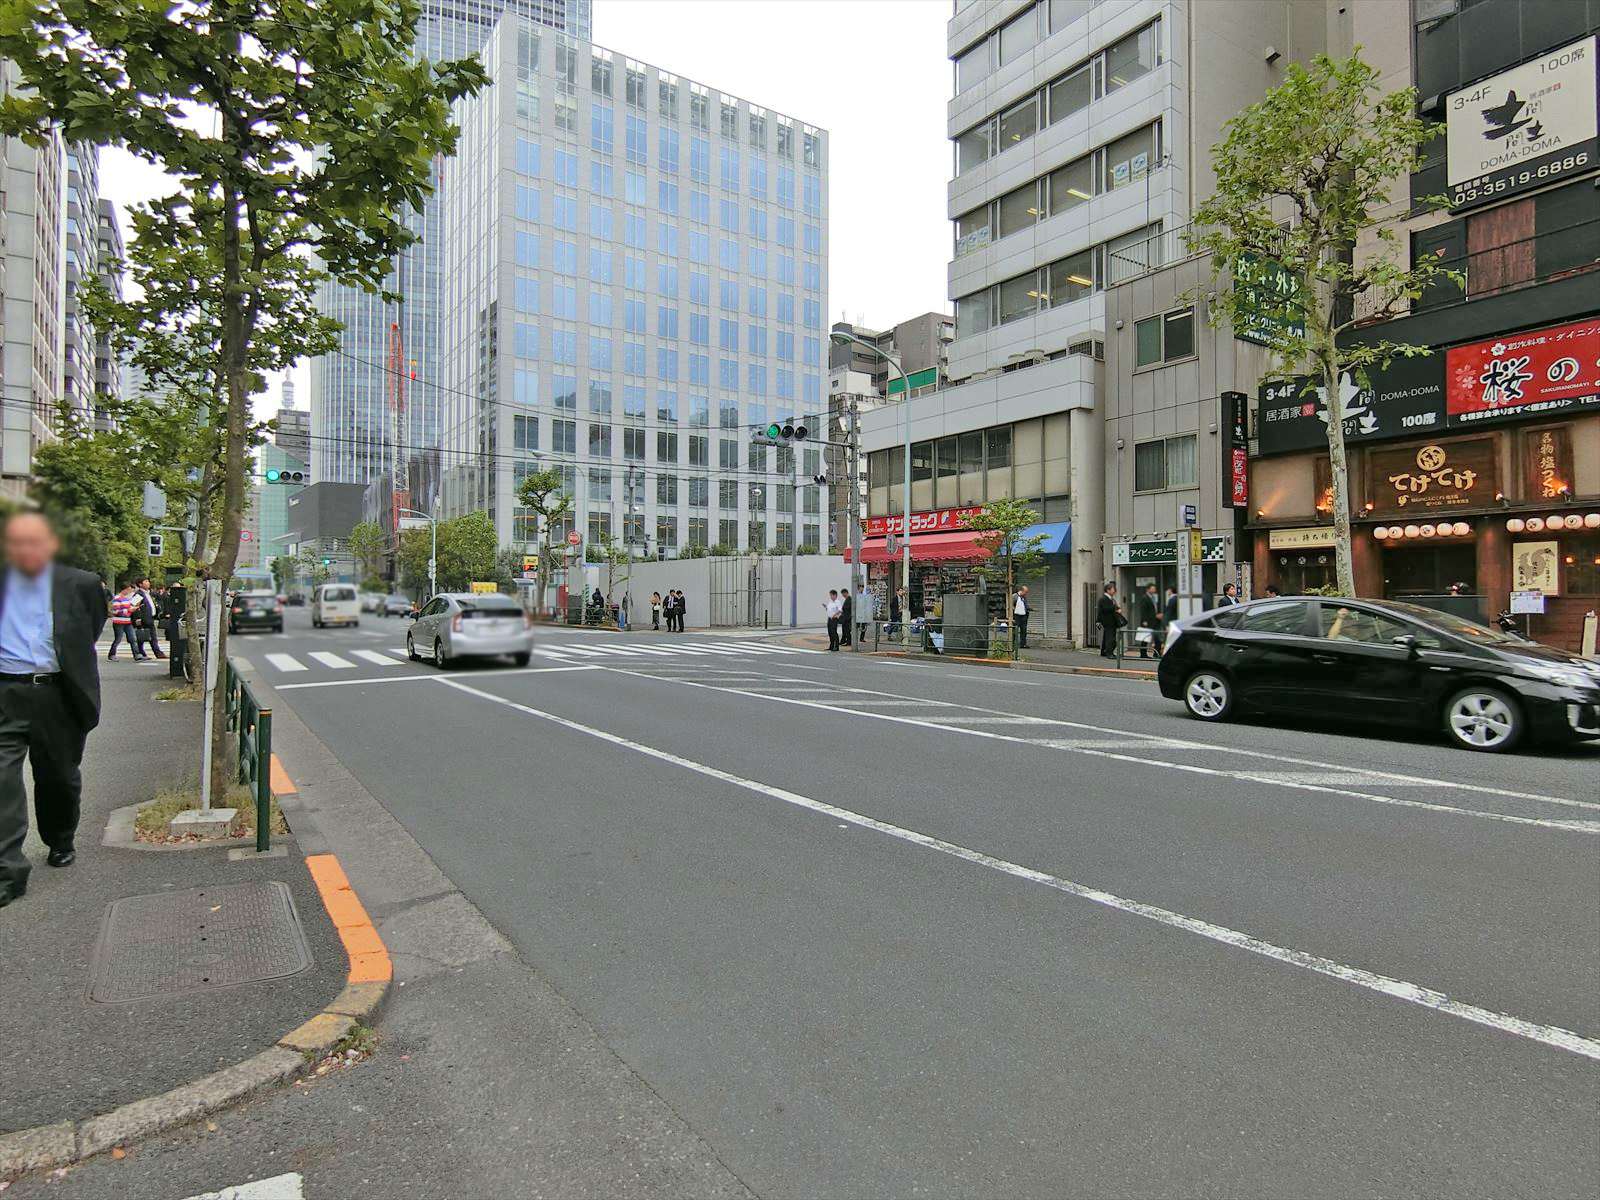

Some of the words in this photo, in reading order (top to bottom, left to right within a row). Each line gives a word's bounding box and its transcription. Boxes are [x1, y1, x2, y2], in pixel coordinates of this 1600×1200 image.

[1540, 47, 1585, 74] 100席
[1480, 136, 1562, 170] DOMA-DOMA
[1455, 152, 1588, 205] 03-3519-6886
[1380, 385, 1440, 402] DOMA-DOMA
[1401, 412, 1436, 428] 100席
[1540, 432, 1556, 498] 名物塩つくね
[1389, 468, 1477, 493] てけてけ
